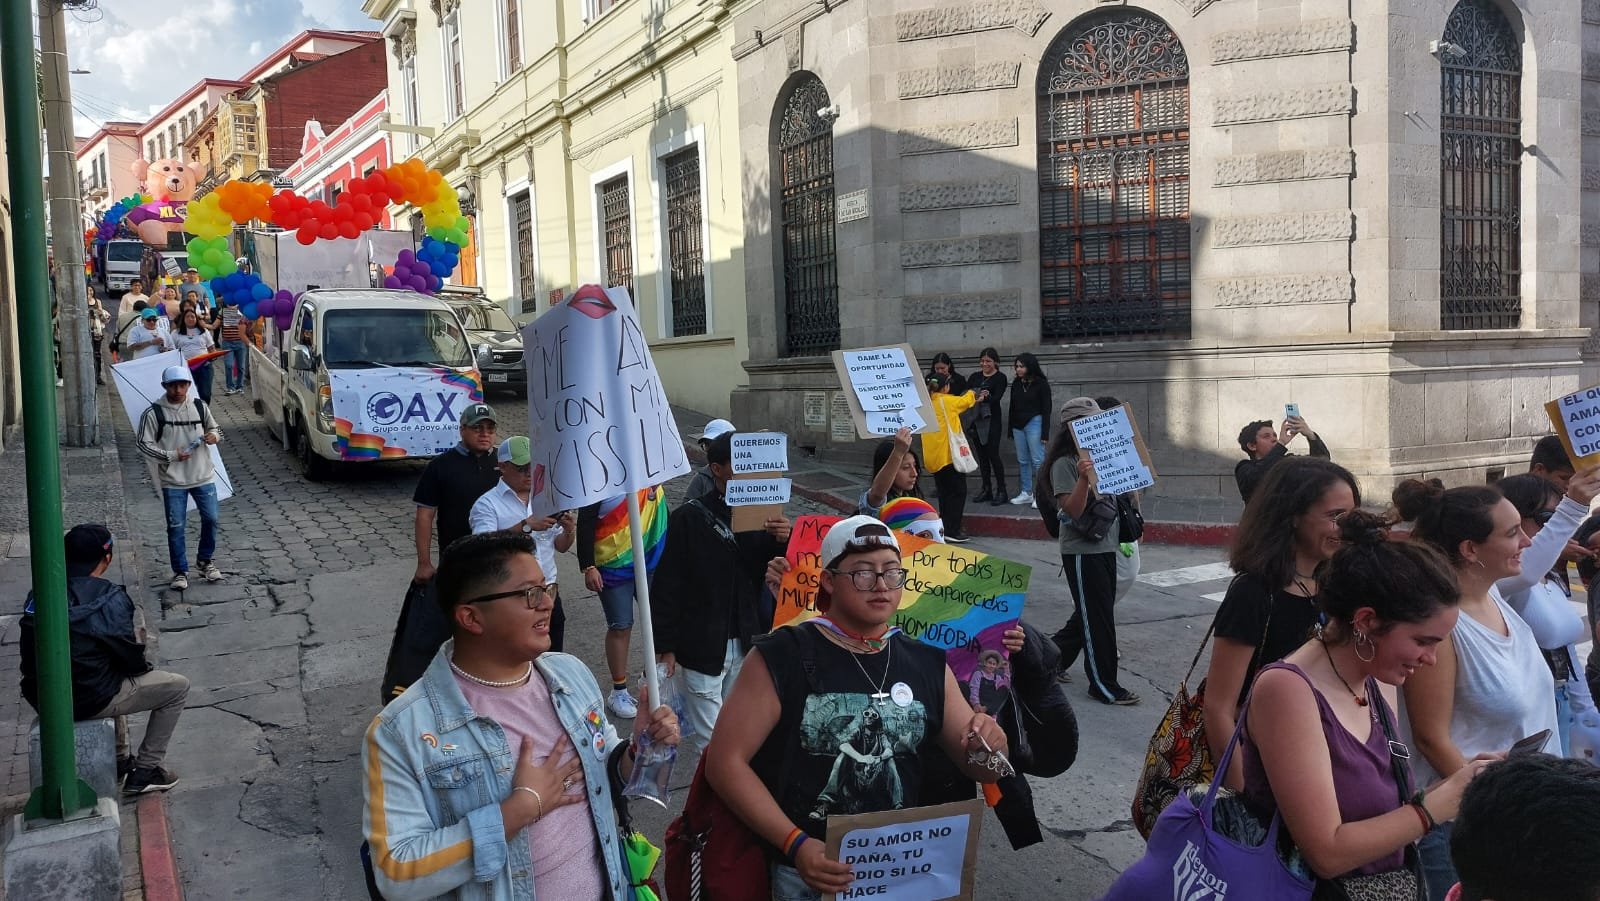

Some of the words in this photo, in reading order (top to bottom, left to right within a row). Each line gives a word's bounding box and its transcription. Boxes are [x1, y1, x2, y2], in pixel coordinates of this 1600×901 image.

[272, 176, 292, 185] HOTEL
[617, 314, 648, 376] AY
[857, 354, 880, 362] DAME
[850, 363, 905, 372] OPORTUNIDAD
[858, 382, 911, 392] DEMOSTRARTE
[366, 391, 457, 425] GAX
[555, 392, 605, 432] CON
[631, 376, 661, 413] MI
[1563, 395, 1583, 406] EL
[1074, 409, 1119, 427] CUALQUIERA
[414, 424, 439, 432] Apoyo
[1077, 426, 1092, 435] QUE
[734, 438, 781, 447] QUEREMOS
[1080, 429, 1114, 443] LIBERTAD
[1110, 435, 1125, 443] QUE
[549, 425, 627, 506] KISS
[640, 407, 684, 478] LIS
[1094, 454, 1114, 464] DEBE
[1115, 449, 1128, 457] SER
[734, 462, 785, 471] GUATEMALA
[1097, 463, 1113, 472] UNA
[1100, 465, 1134, 480] LIBERTAD
[1100, 478, 1128, 490] BASADA
[728, 495, 784, 503] DISCRIMINACION
[796, 572, 819, 587] as
[1001, 565, 1024, 588] lxs
[904, 571, 1009, 612] desaparecidxs
[896, 614, 982, 652] HOMOFOBIA
[847, 838, 869, 849] SU
[875, 830, 923, 847] AMOR
[928, 827, 952, 838] NO
[845, 852, 896, 865] DAÑA,
[902, 849, 923, 860] TU
[850, 869, 885, 880] DIO
[890, 867, 905, 876] SI
[911, 863, 932, 874] LO
[842, 884, 888, 900] HACE
